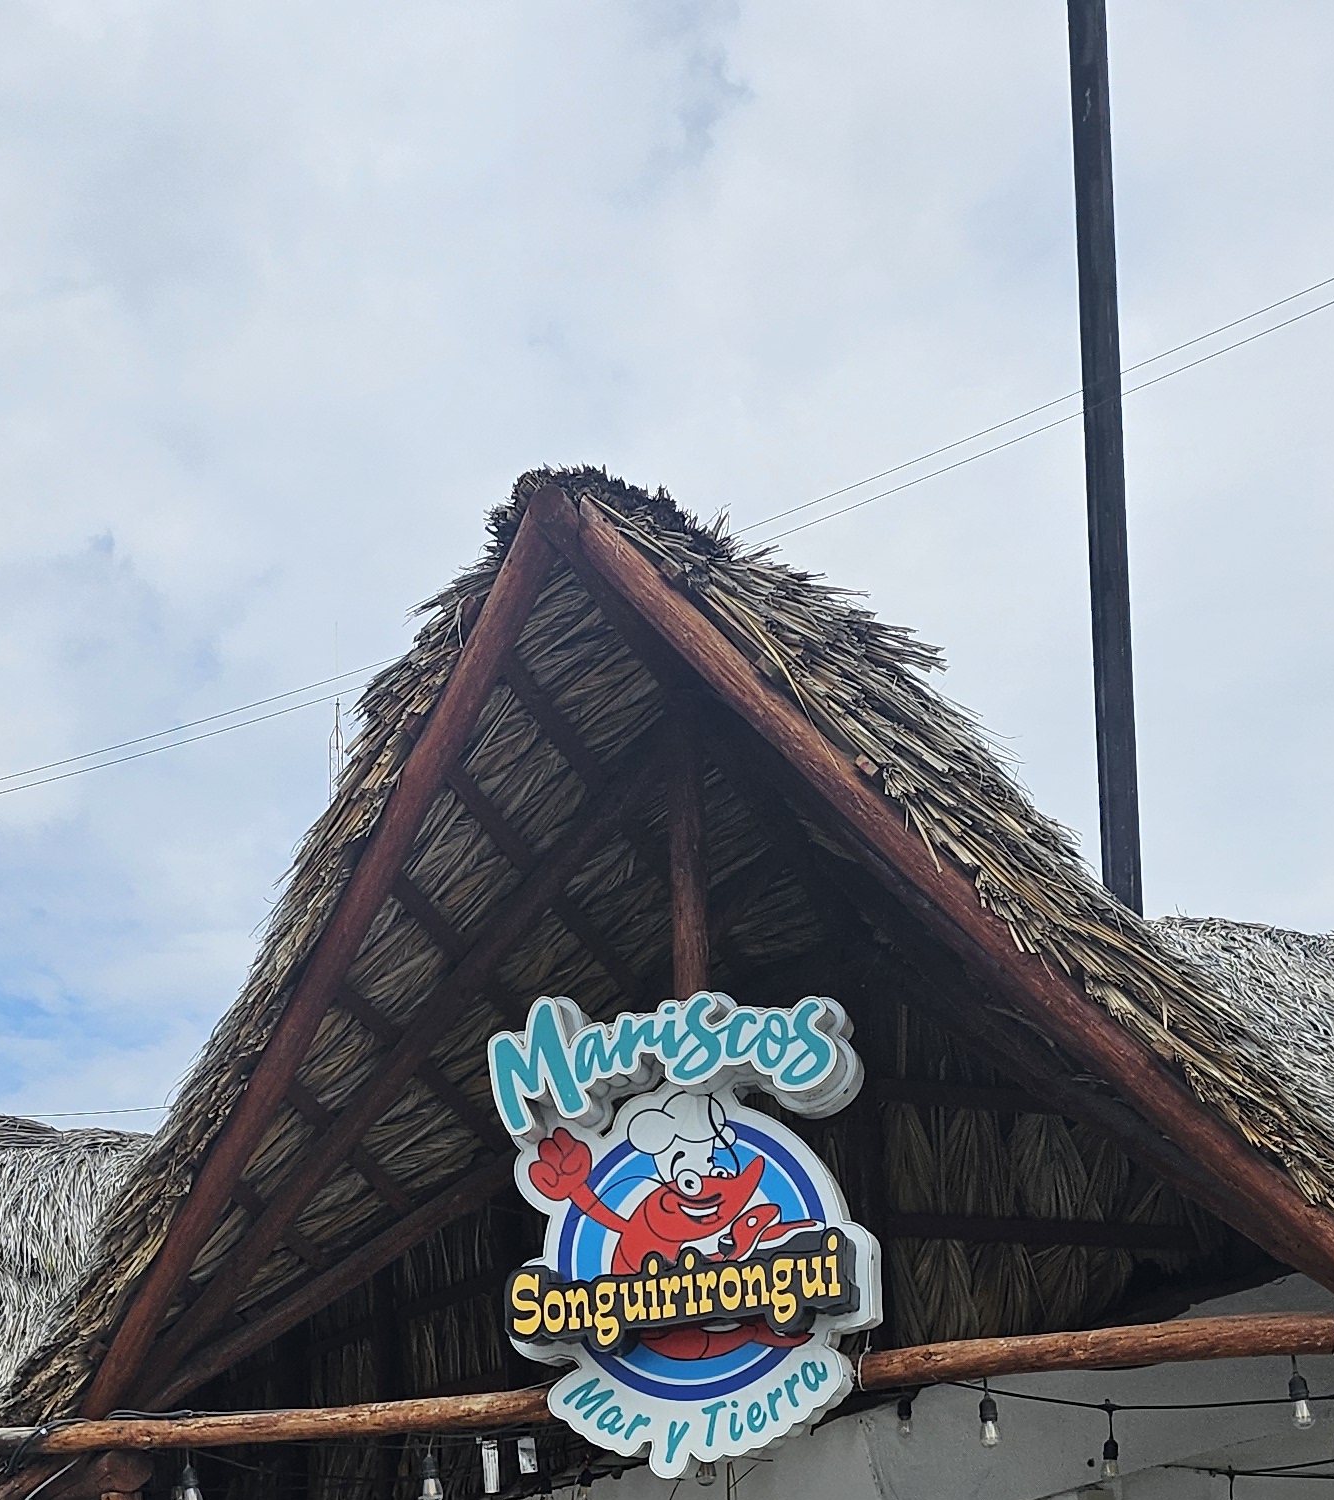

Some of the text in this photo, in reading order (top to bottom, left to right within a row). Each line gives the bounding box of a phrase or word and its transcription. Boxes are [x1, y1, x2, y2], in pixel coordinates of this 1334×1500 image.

[494, 996, 832, 1131] Mariscos
[512, 1235, 842, 1347] Songuirirongui
[562, 1360, 829, 1464] Mar y Tierra
